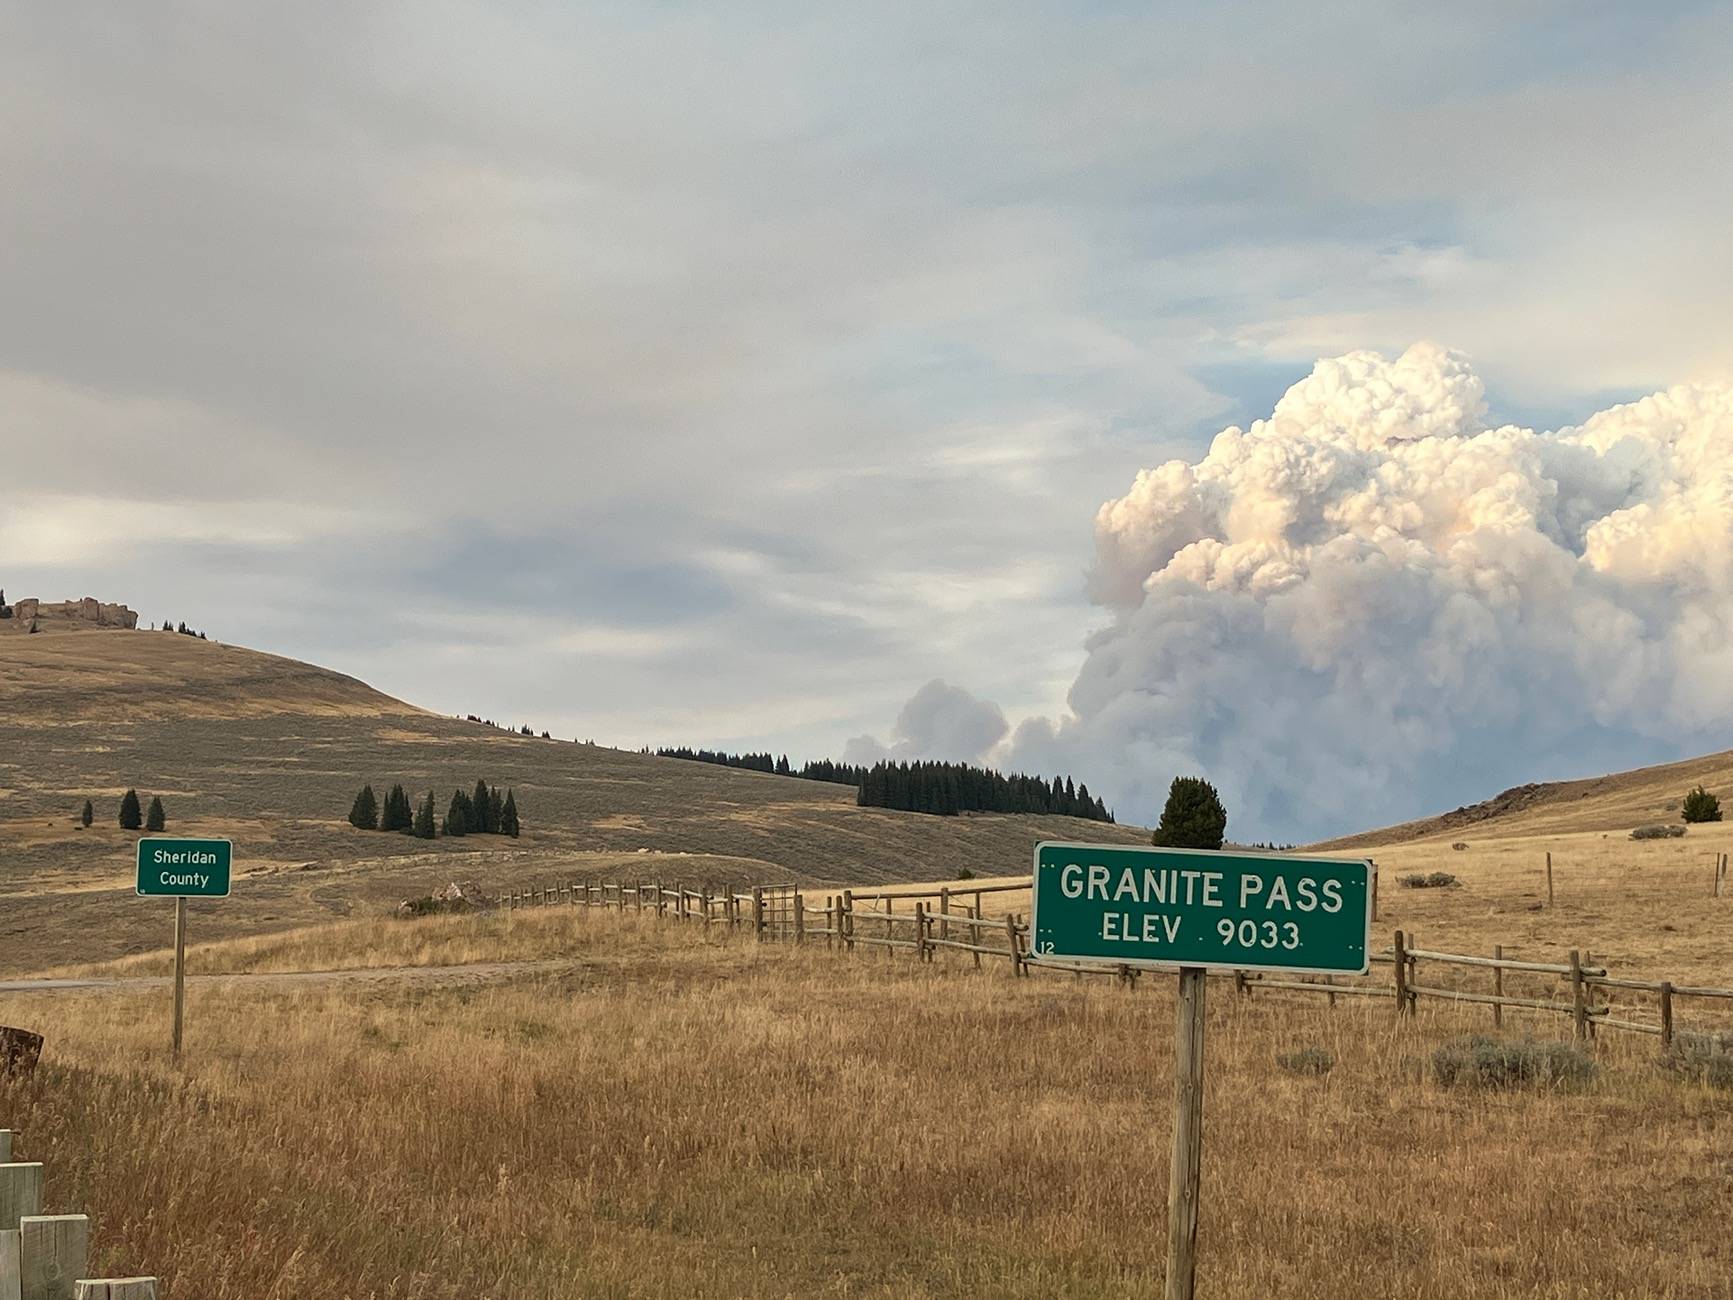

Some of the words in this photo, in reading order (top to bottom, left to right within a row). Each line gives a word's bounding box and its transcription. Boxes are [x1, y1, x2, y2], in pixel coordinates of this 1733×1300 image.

[153, 849, 217, 865] Sheridan
[160, 871, 209, 889] County
[1060, 863, 1224, 908] GRANITE
[1239, 873, 1343, 914] PASS
[1102, 912, 1182, 943] ELEV
[1216, 918, 1300, 950] 9033
[1040, 941, 1055, 955] 12
